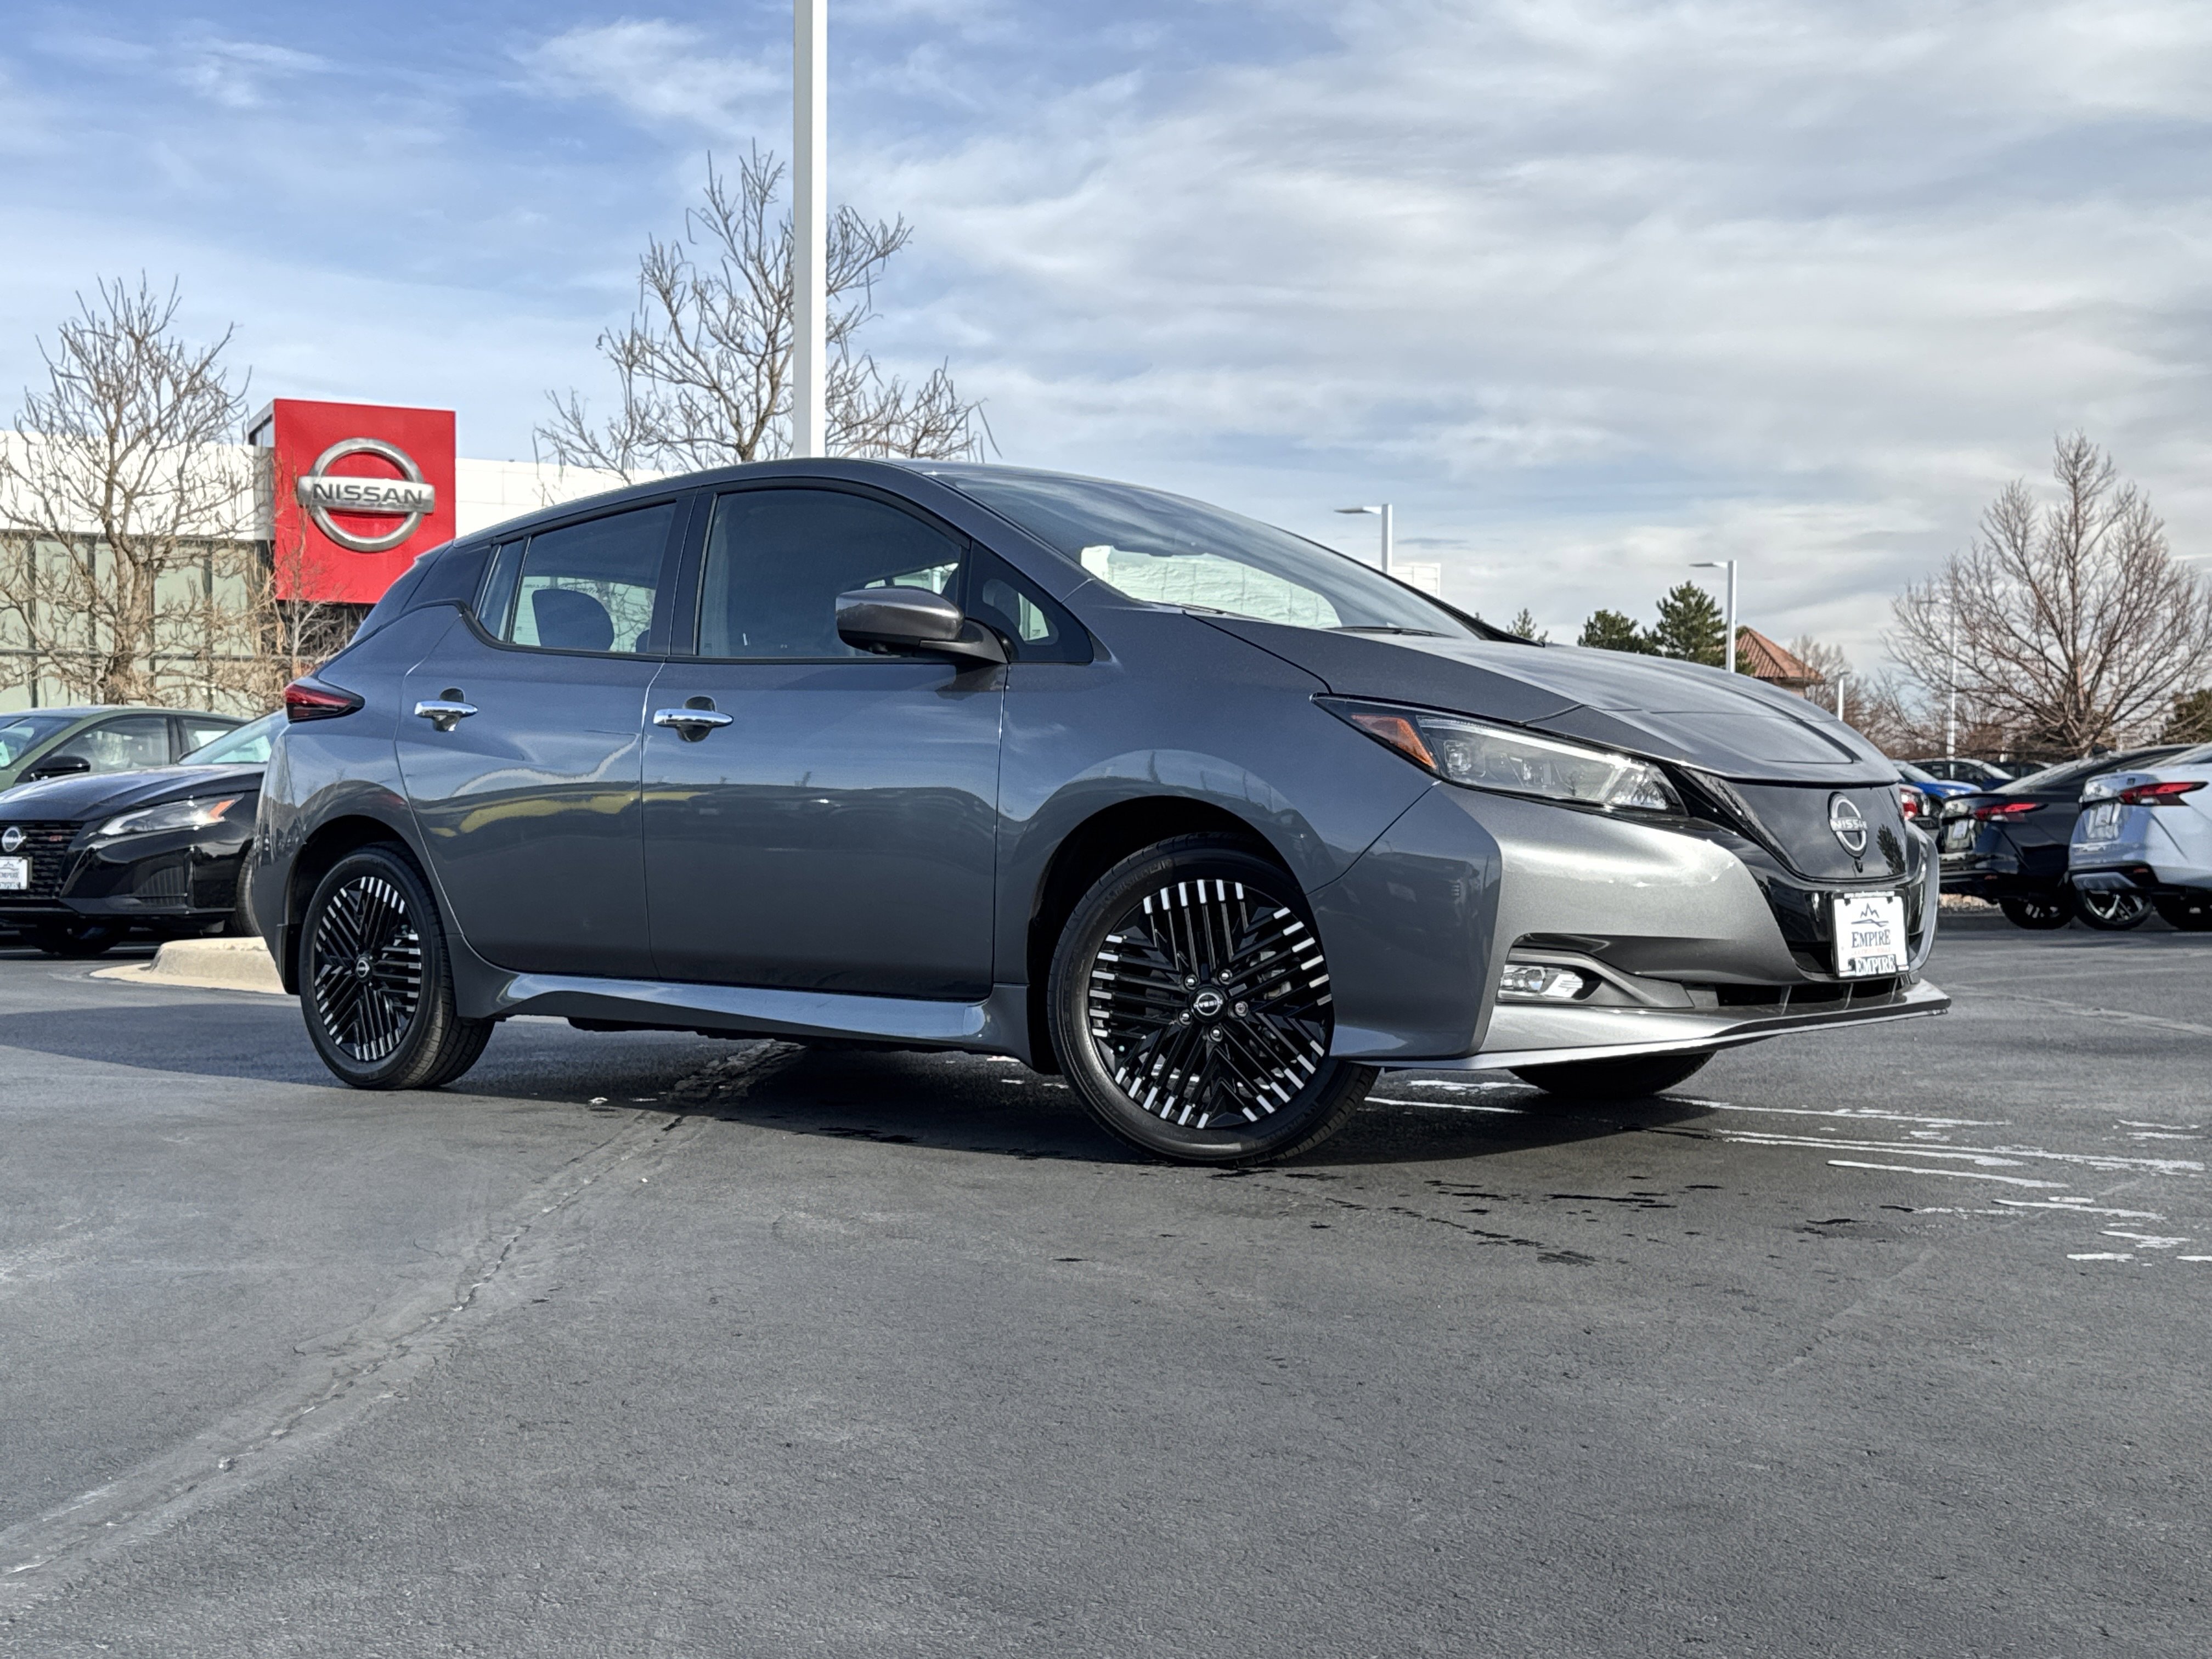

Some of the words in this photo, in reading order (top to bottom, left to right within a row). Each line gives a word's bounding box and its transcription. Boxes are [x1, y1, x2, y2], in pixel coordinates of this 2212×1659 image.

[312, 483, 422, 504] NISSAN
[1830, 819, 1867, 830] NISSAN
[1851, 929, 1891, 948] EMPIRE
[1855, 955, 1896, 976] EMPIRE
